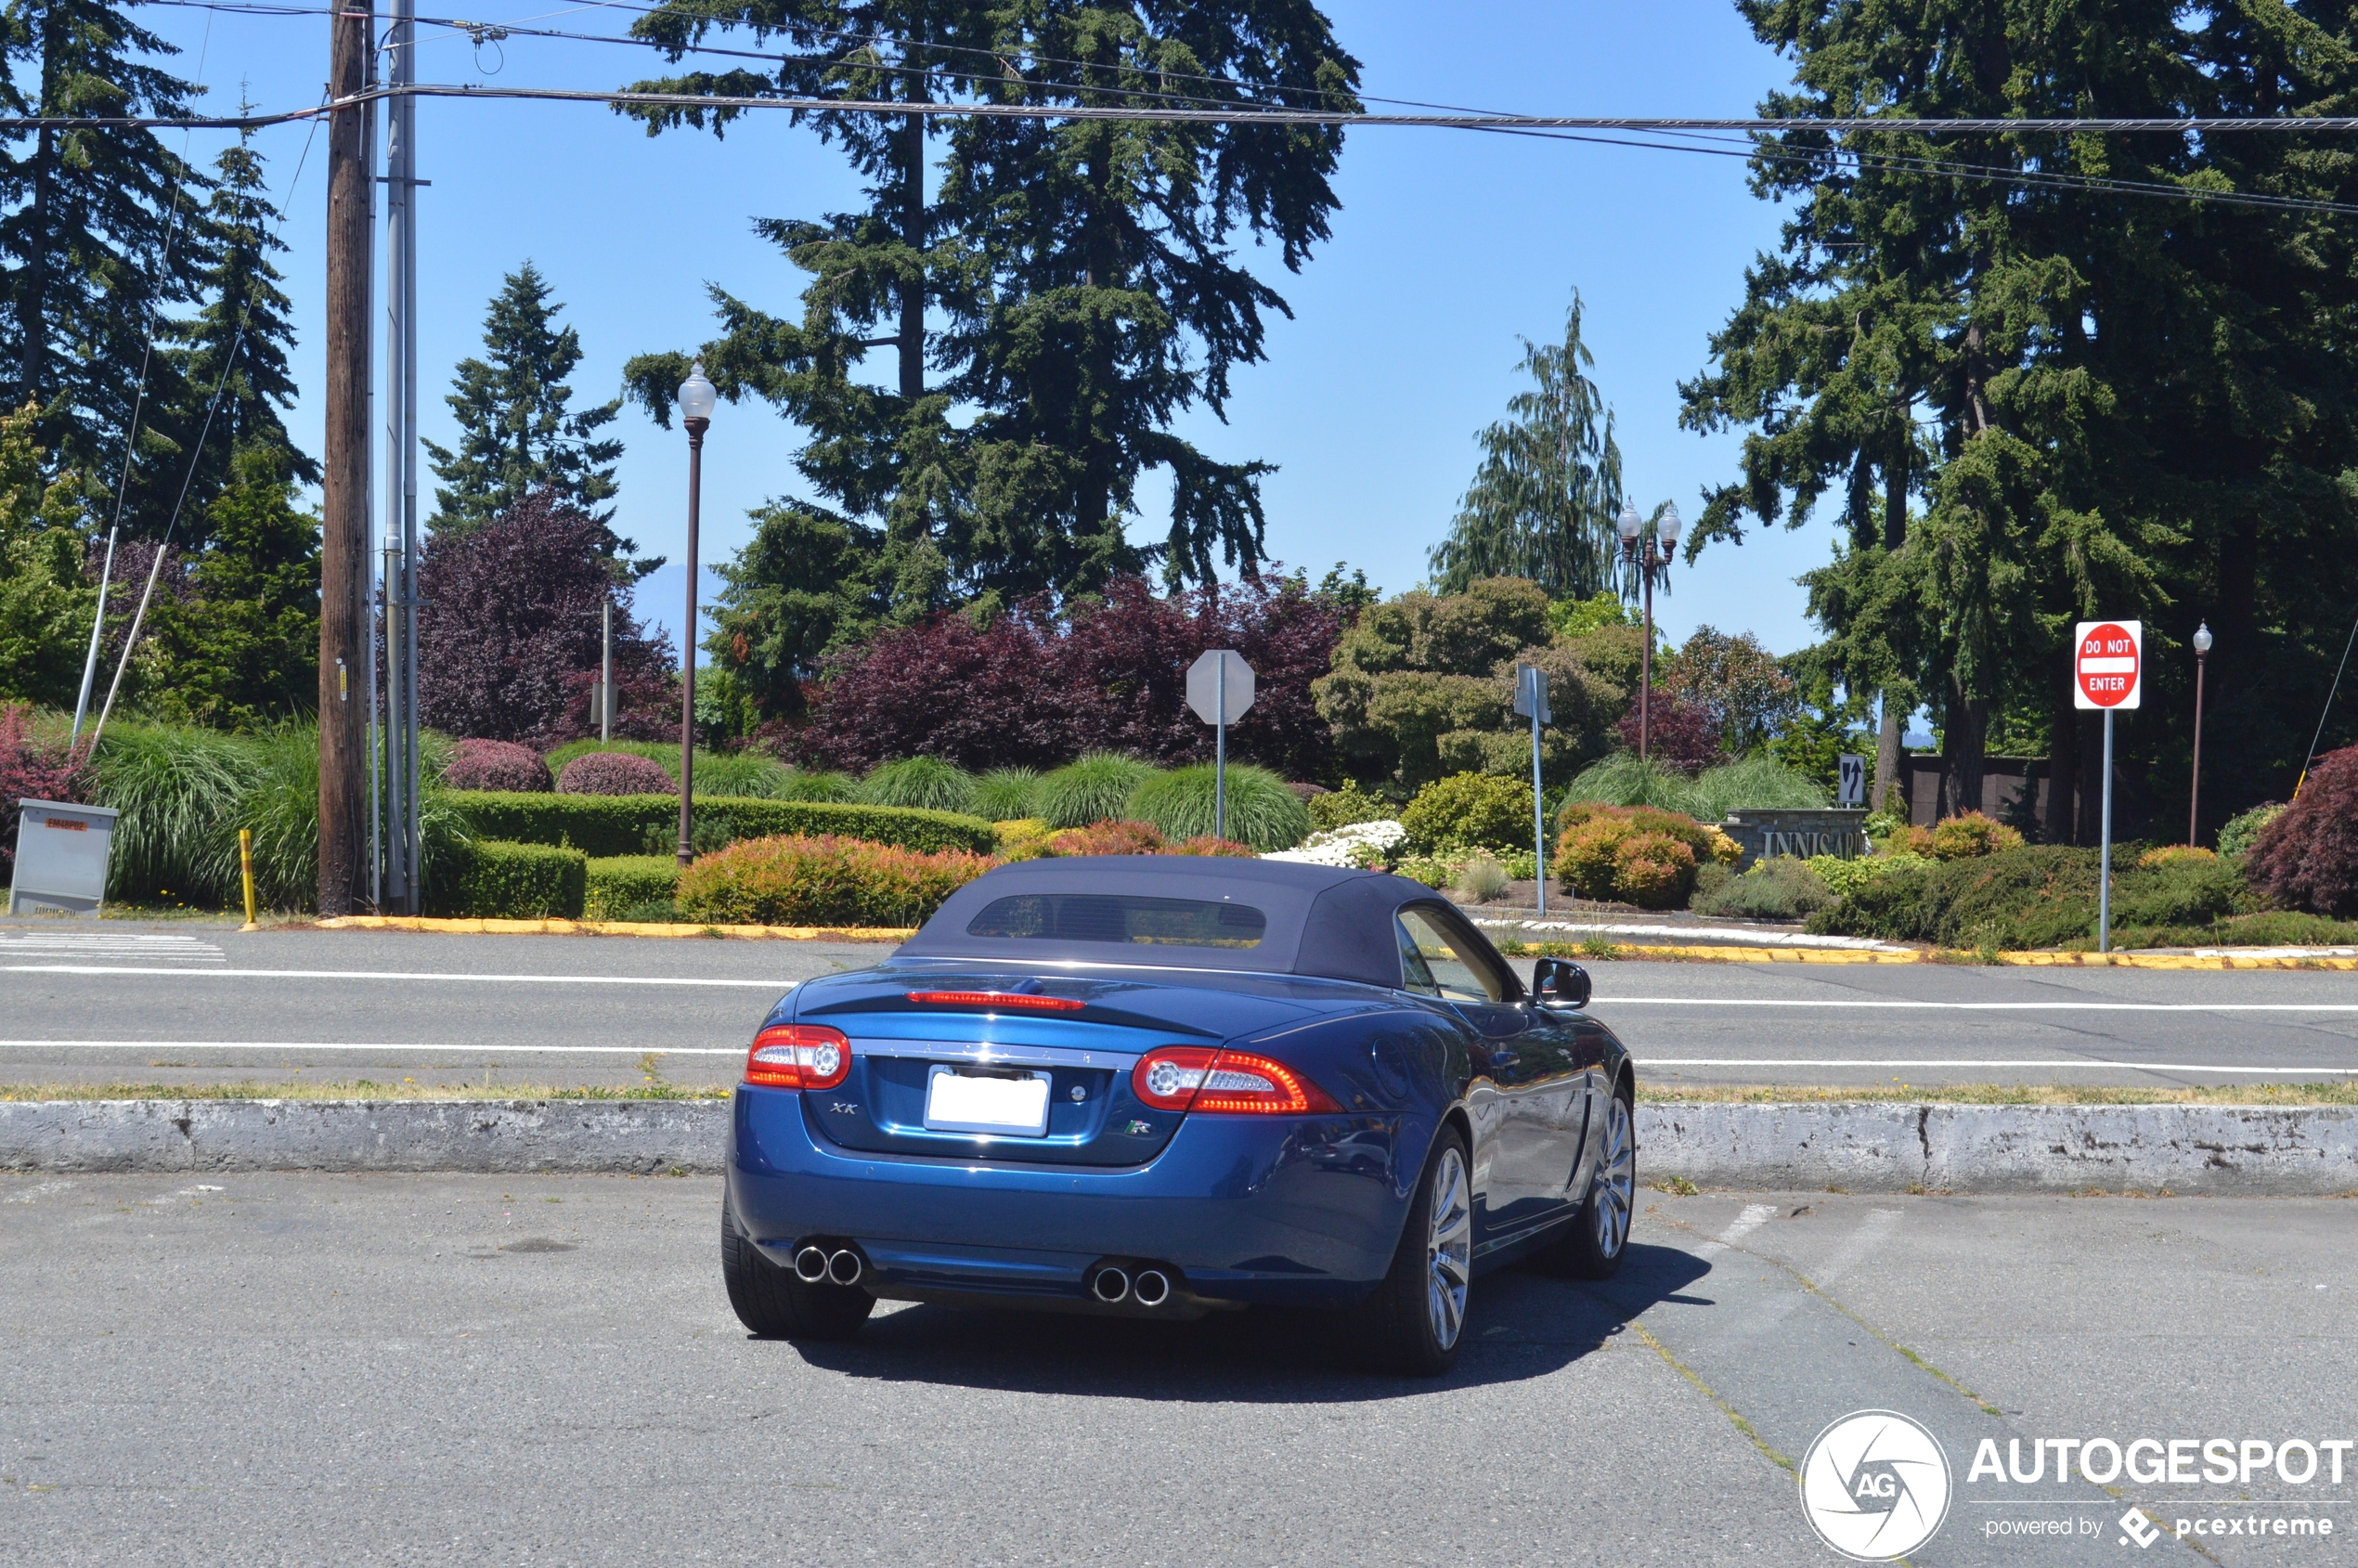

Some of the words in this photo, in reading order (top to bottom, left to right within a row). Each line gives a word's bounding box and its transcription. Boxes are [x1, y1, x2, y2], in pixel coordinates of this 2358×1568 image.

[2085, 641, 2101, 654] DO
[2107, 640, 2130, 653] NOT
[2089, 678, 2124, 691] ENTER
[830, 1103, 858, 1114] XK
